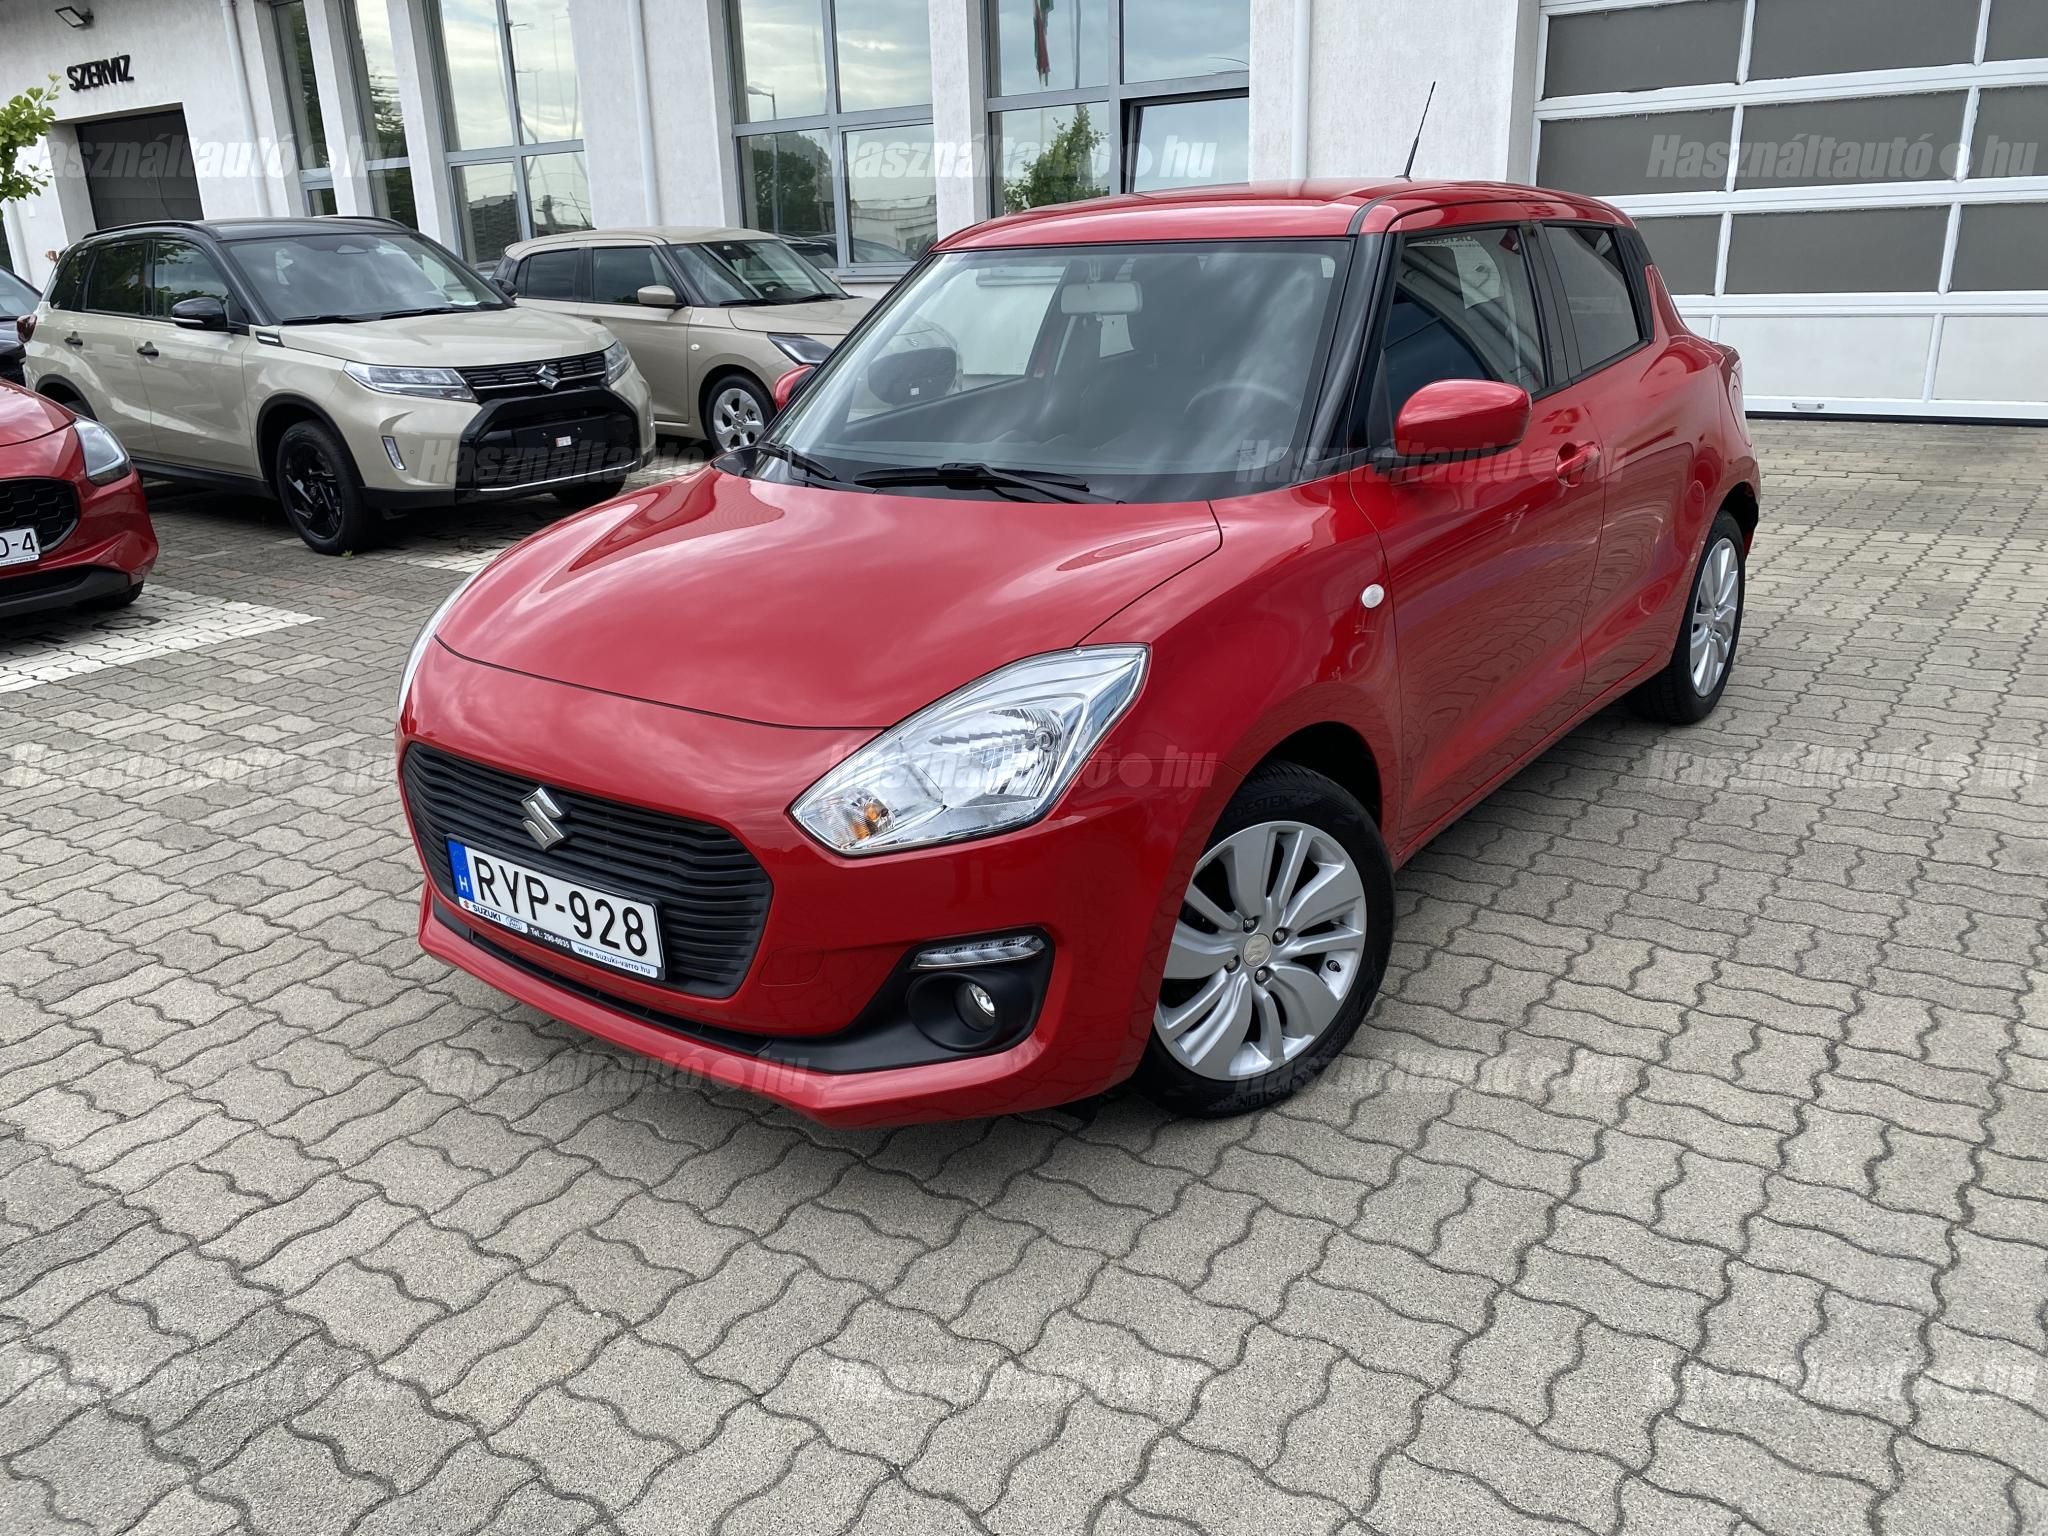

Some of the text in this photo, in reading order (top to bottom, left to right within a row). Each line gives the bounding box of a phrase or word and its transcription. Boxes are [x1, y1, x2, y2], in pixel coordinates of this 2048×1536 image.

[66, 55, 134, 91] SZERVIZ
[459, 874, 469, 894] H
[472, 904, 501, 921] SUZUKI
[473, 856, 648, 956] RYP-928
